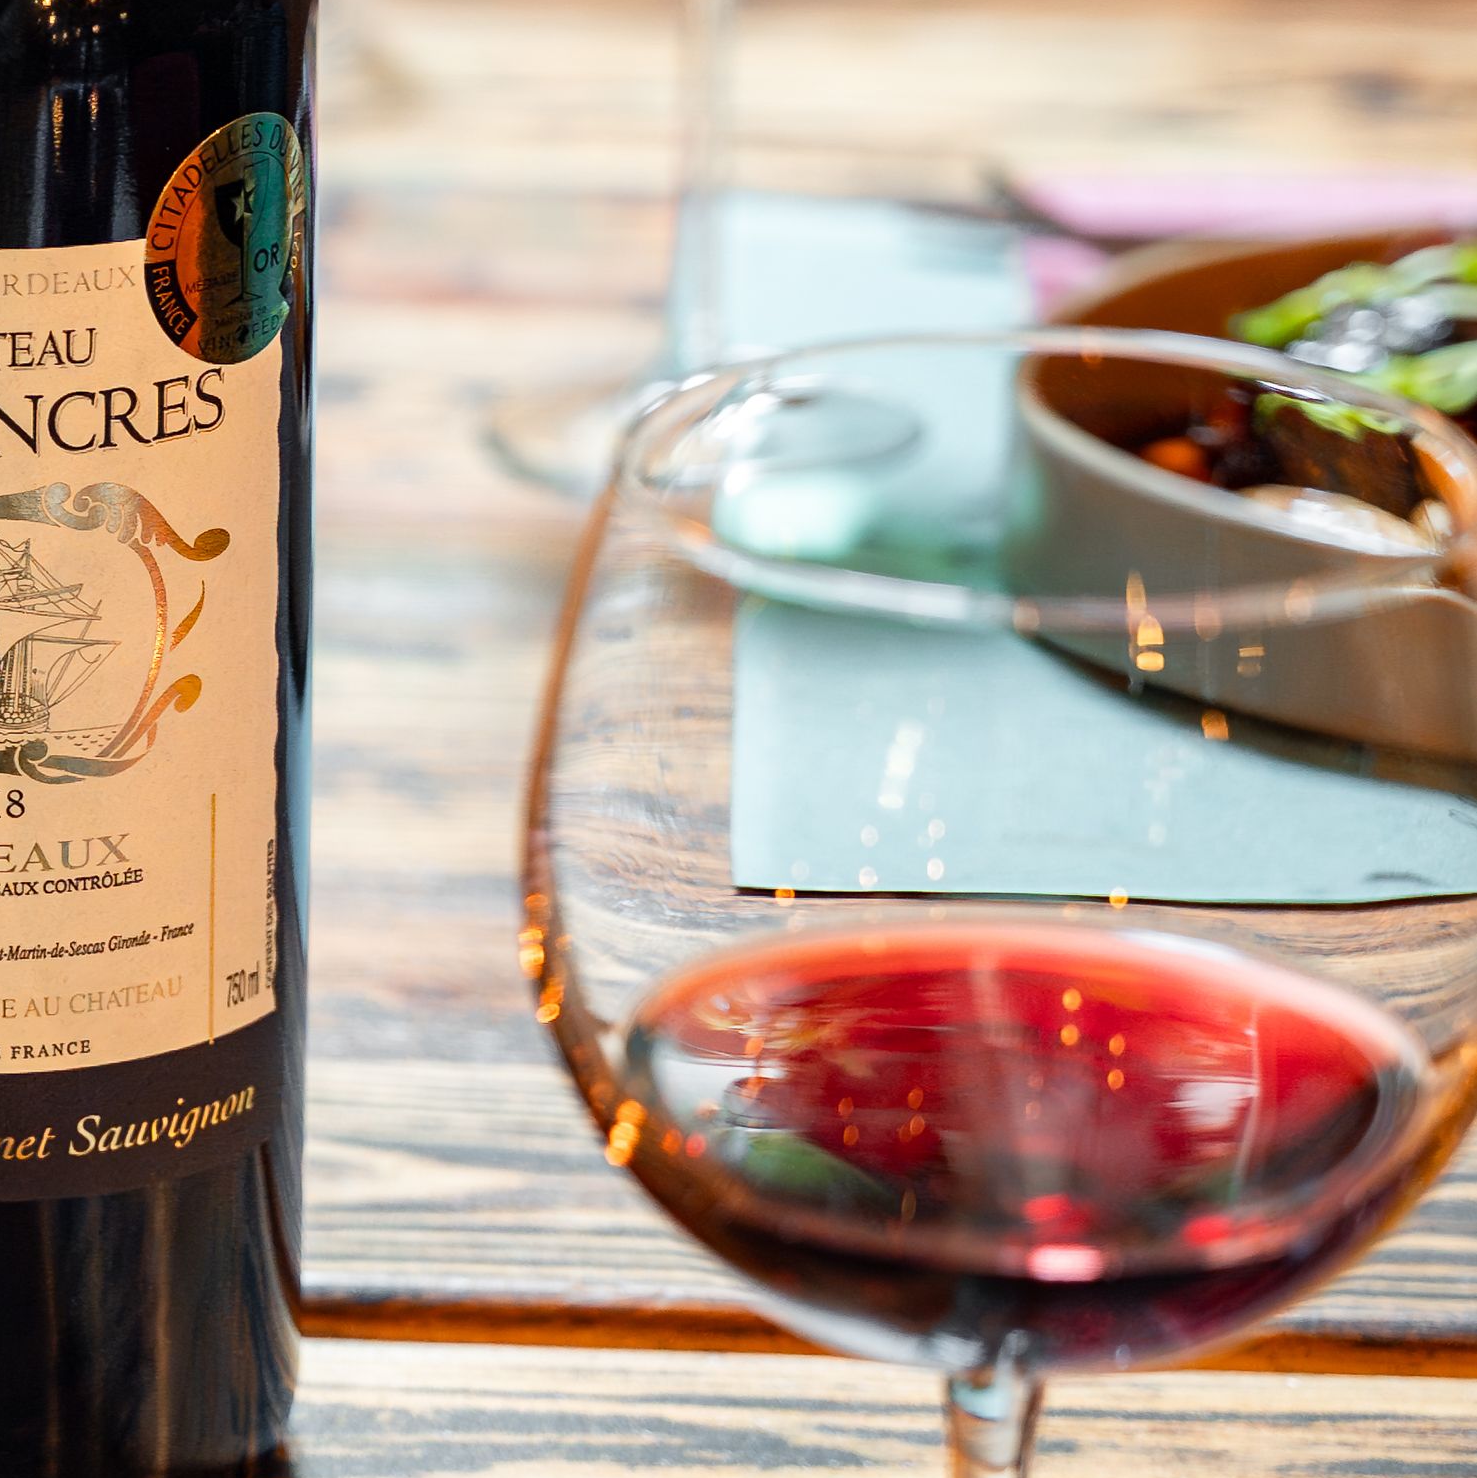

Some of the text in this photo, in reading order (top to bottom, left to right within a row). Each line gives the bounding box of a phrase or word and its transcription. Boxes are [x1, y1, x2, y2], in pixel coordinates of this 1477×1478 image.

[151, 122, 264, 251] CITADELLES
[269, 122, 291, 157] DU
[253, 242, 281, 273] OR
[152, 266, 190, 337] FRANCE
[43, 868, 144, 894] CONTRÔLÉE
[108, 930, 151, 952] Gironde
[160, 922, 195, 942] France
[24, 996, 61, 1018] AU
[69, 976, 183, 1013] CHATEAU
[226, 959, 261, 1008] 750 ml
[10, 1039, 91, 1060] FRANCE
[68, 1082, 255, 1156] Sauvignon
